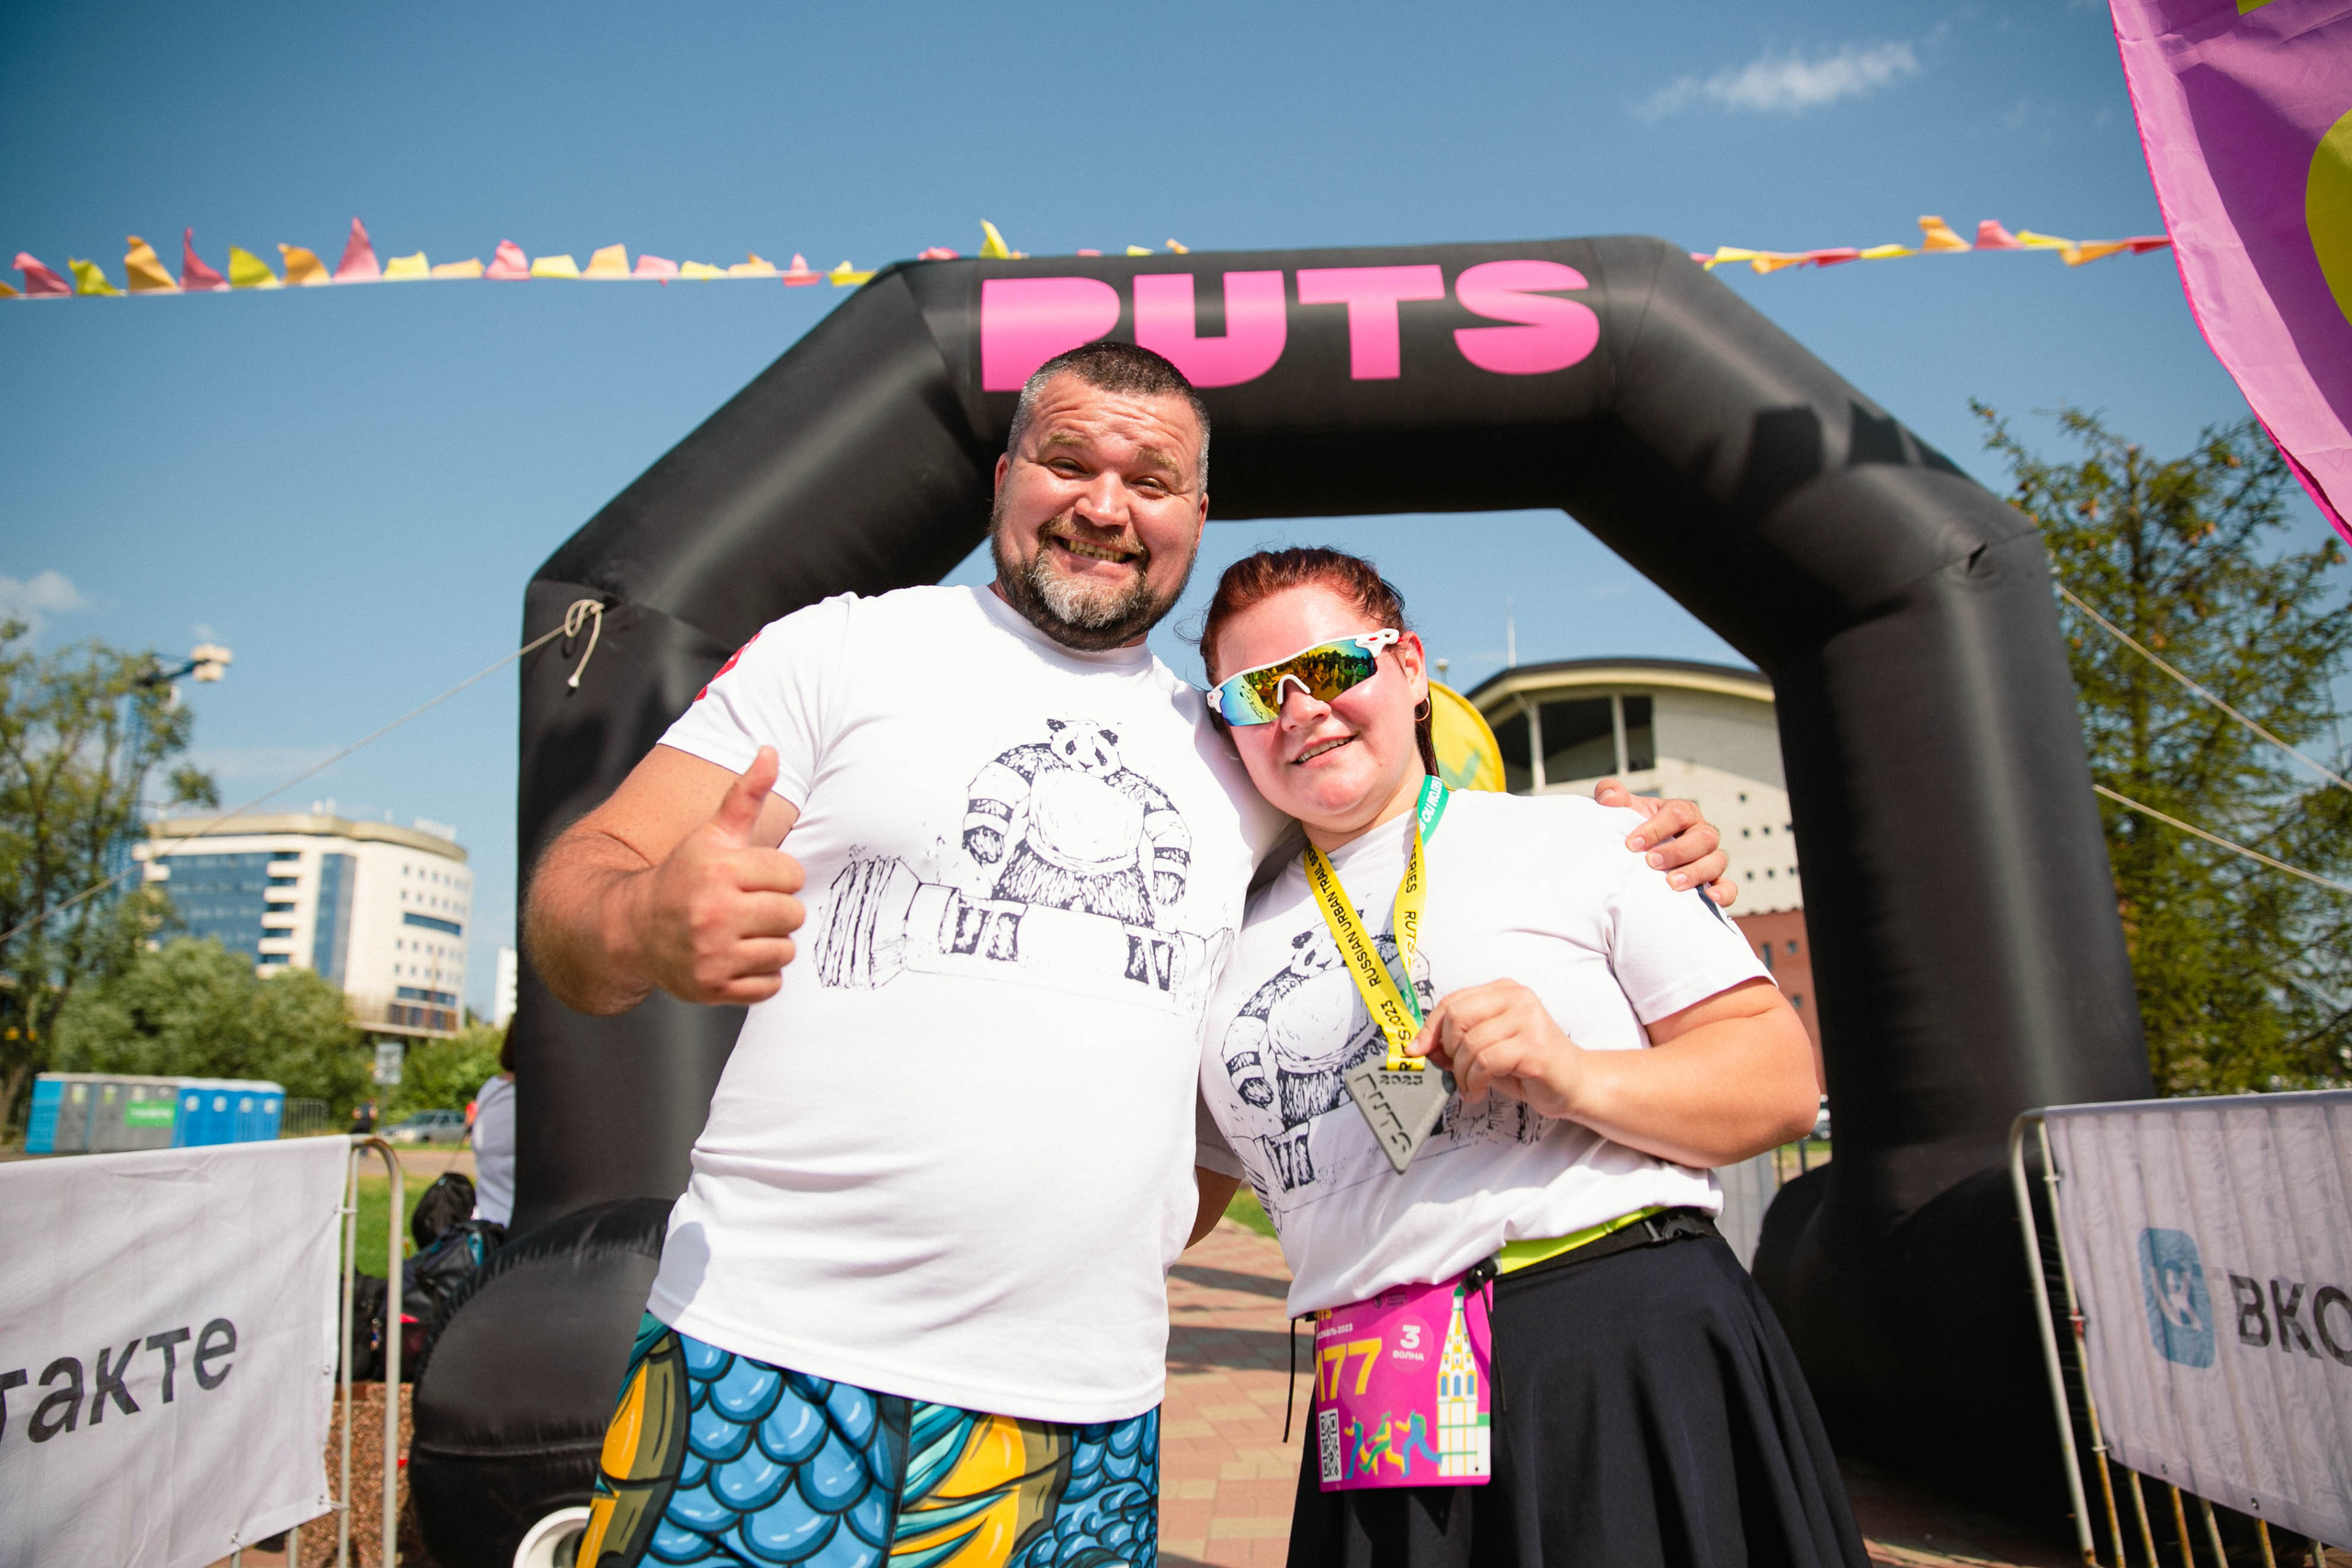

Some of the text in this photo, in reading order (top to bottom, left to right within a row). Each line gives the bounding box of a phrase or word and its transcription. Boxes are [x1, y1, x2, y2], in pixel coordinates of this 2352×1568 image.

[980, 259, 1600, 392] RUTS
[1421, 803, 1436, 823] ПО
[1314, 863, 1333, 894] TRAIL
[1406, 844, 1418, 894] ERIES
[1326, 891, 1352, 933] URBAN
[1404, 910, 1418, 954] RUTS
[1345, 931, 1382, 987] RUSSIAN
[1380, 999, 1405, 1027] 023
[1338, 1323, 1353, 1334] 2023
[1399, 1324, 1421, 1349] 3
[1317, 1337, 1383, 1403] 177
[1392, 1349, 1424, 1361] ВОЛНА
